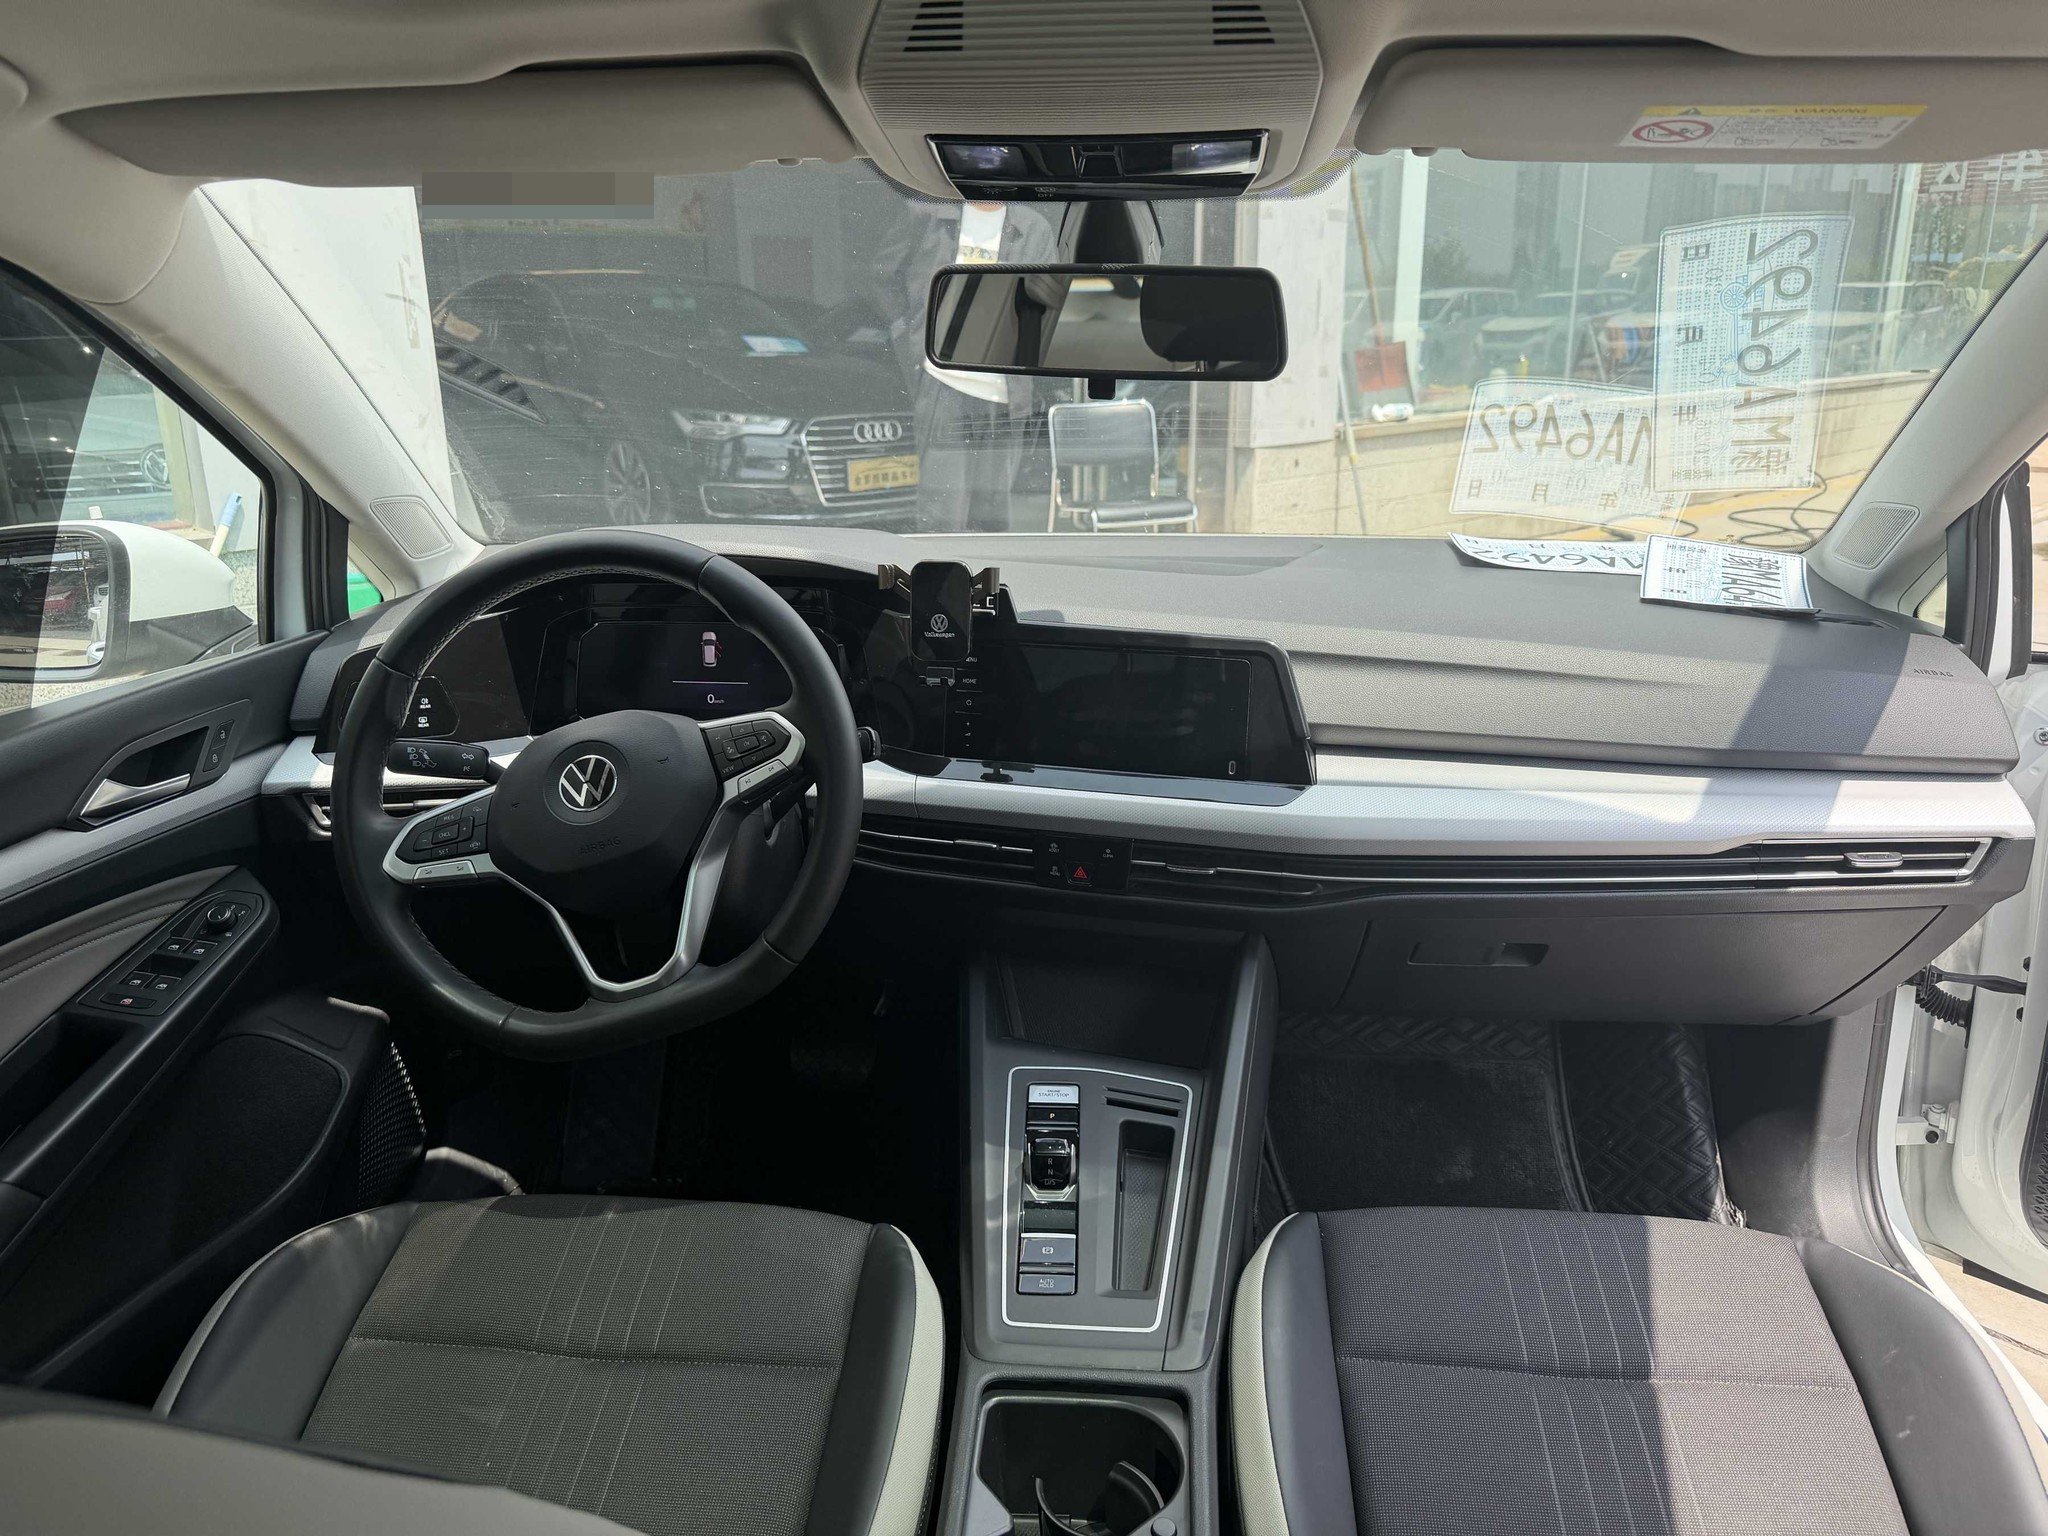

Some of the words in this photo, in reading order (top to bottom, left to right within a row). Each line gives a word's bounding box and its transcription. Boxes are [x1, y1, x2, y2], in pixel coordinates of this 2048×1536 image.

[1913, 668, 1954, 678] AIRBAG
[707, 693, 714, 704] 0
[578, 836, 622, 856] AIRBAG
